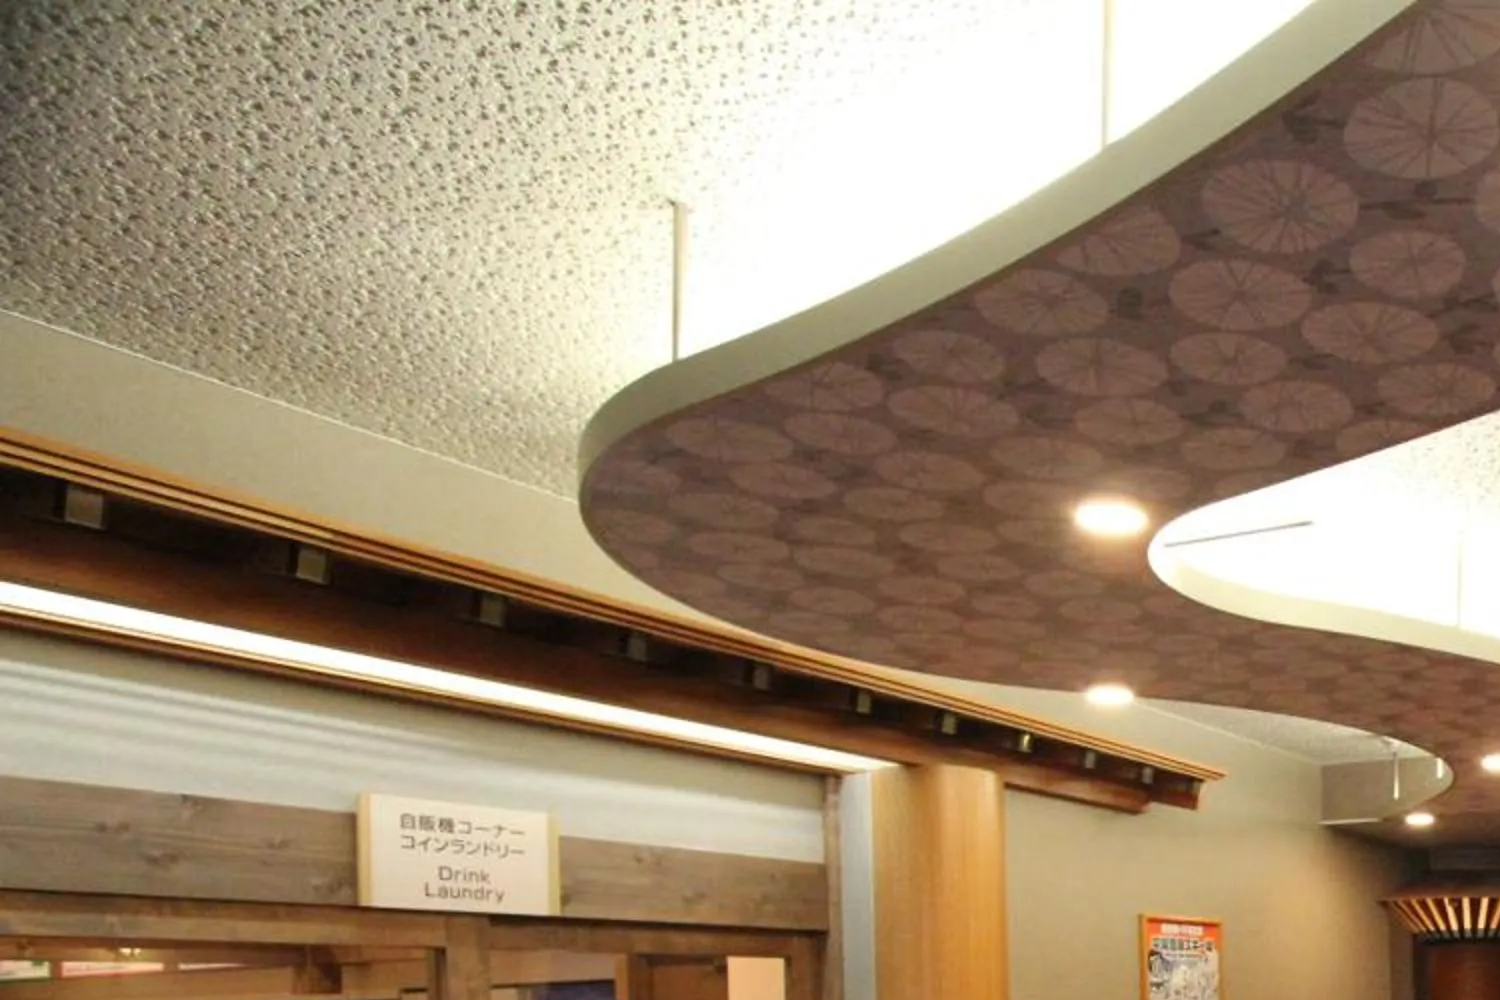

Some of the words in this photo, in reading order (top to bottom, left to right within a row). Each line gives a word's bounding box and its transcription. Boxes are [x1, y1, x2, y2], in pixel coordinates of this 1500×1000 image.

[400, 813, 525, 837] 自販機コーナー
[401, 835, 525, 858] コインランドリー
[439, 866, 491, 883] Drink
[425, 883, 505, 903] Laundry
